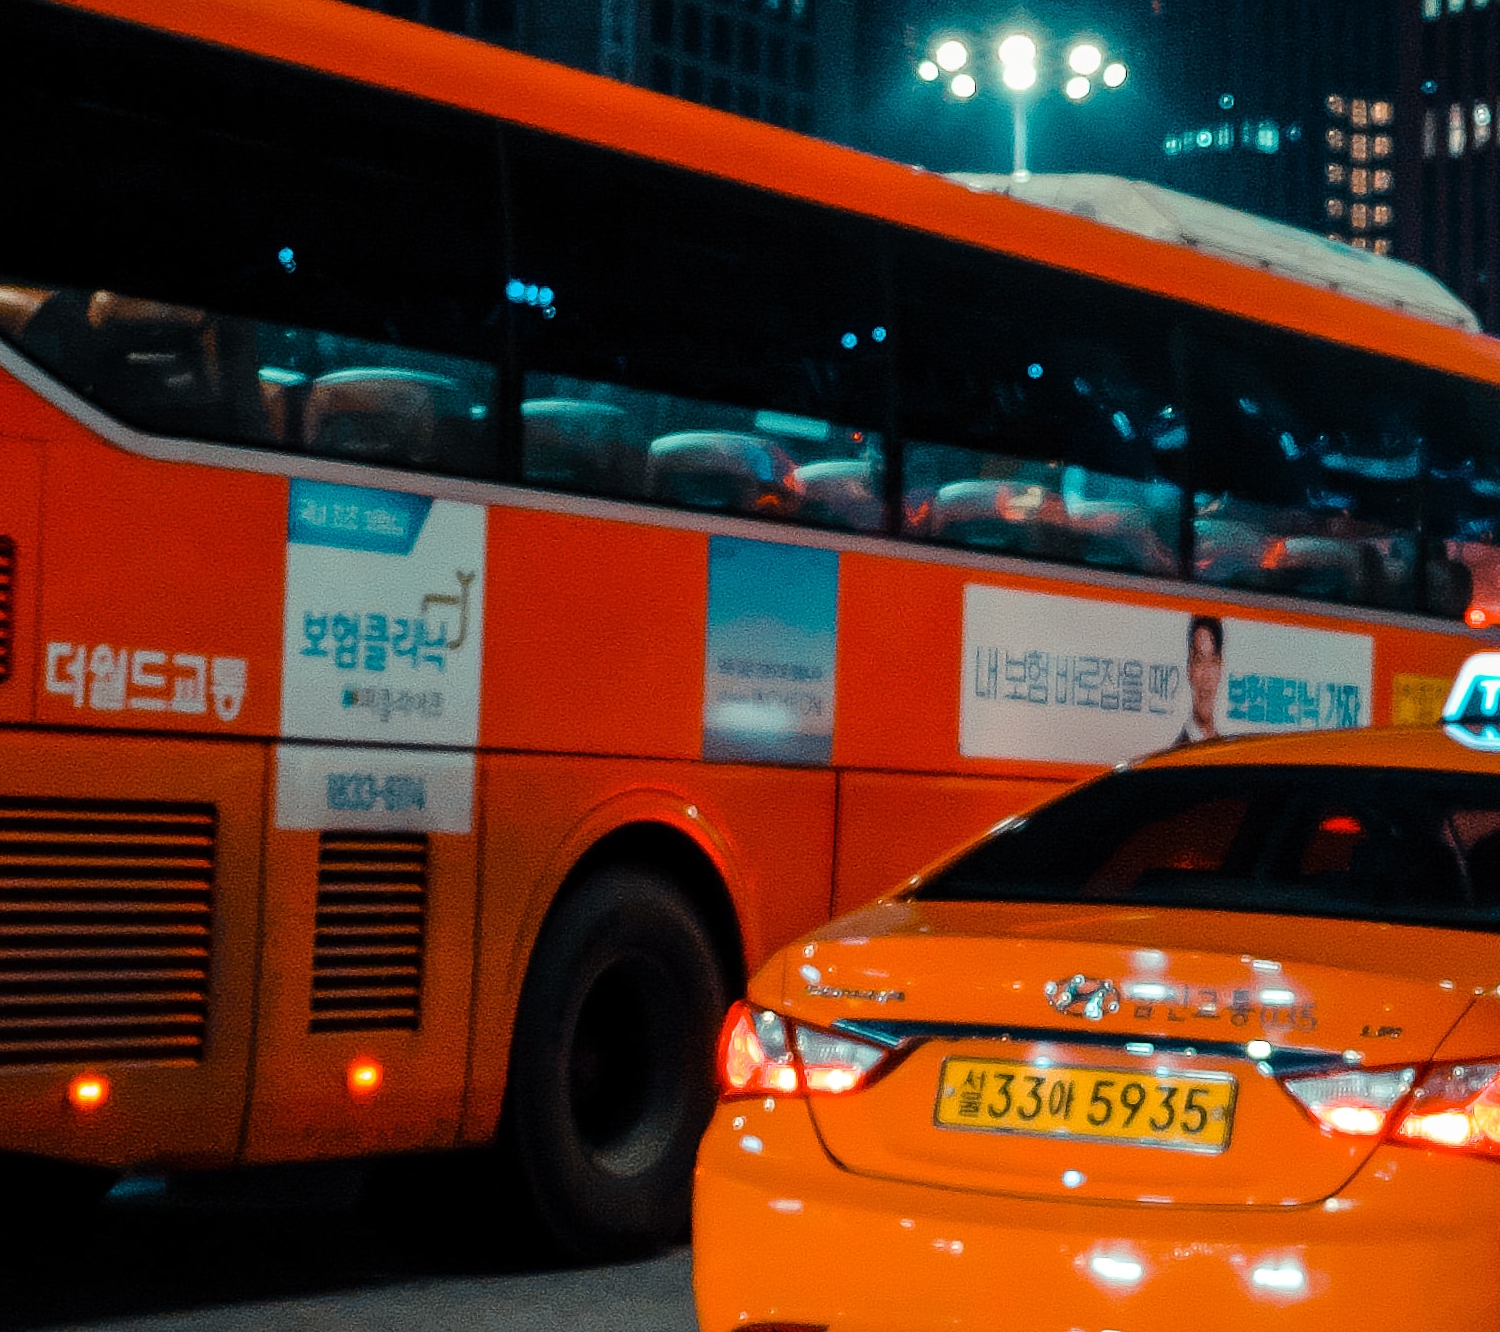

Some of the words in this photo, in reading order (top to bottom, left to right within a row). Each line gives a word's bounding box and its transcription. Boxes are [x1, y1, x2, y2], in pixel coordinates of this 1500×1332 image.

[300, 611, 447, 673] 보험클리닉
[46, 642, 248, 722] 더월드교통
[974, 646, 999, 701] 내
[1004, 649, 1049, 705] 보험
[1088, 1078, 1210, 1137] 5935
